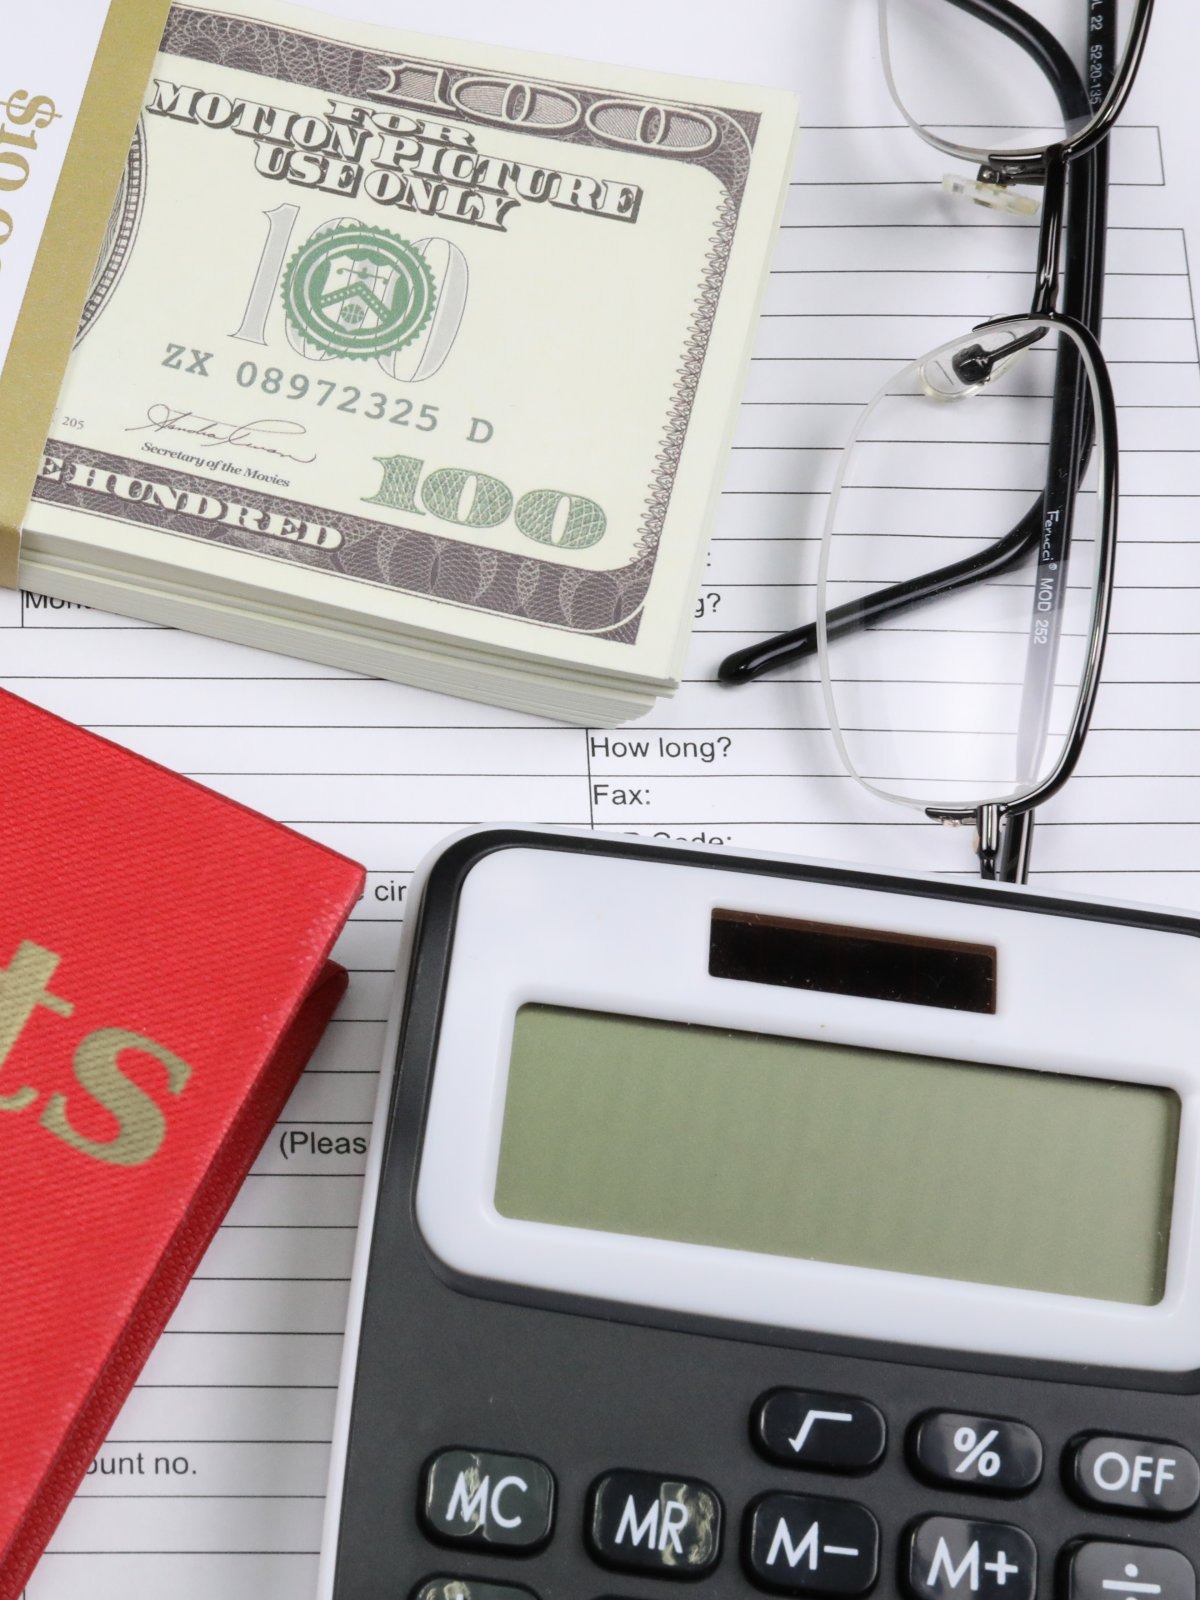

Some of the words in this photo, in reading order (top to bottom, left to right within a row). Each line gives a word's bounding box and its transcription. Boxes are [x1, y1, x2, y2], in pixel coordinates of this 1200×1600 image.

[1090, 15, 1103, 31] 22
[328, 99, 478, 151] FOR
[369, 62, 722, 152] 100
[145, 79, 372, 163] MOTION
[373, 131, 644, 224] PICTURE
[254, 139, 364, 199] USE
[363, 169, 522, 232] ONLY
[161, 343, 214, 377] ZX
[236, 361, 439, 432] 08972325
[465, 416, 494, 445] D
[62, 416, 85, 430] 205
[141, 441, 205, 469] Secretary
[207, 458, 222, 471] of
[222, 460, 242, 475] the
[243, 467, 290, 487] Movies
[64, 462, 345, 550] HUNDRED
[360, 454, 608, 549] 100
[1037, 578, 1054, 612] MOD
[1033, 619, 1049, 645] 252
[591, 736, 650, 758] How
[659, 736, 732, 763] long?
[593, 784, 650, 805] Fax:
[375, 880, 407, 902] cir
[280, 1131, 367, 1160] (Pleas
[155, 1456, 197, 1475] no.
[1093, 1452, 1177, 1497] OFF
[445, 1474, 528, 1529] MC
[614, 1495, 686, 1554] MR
[925, 1537, 1020, 1592] M+
